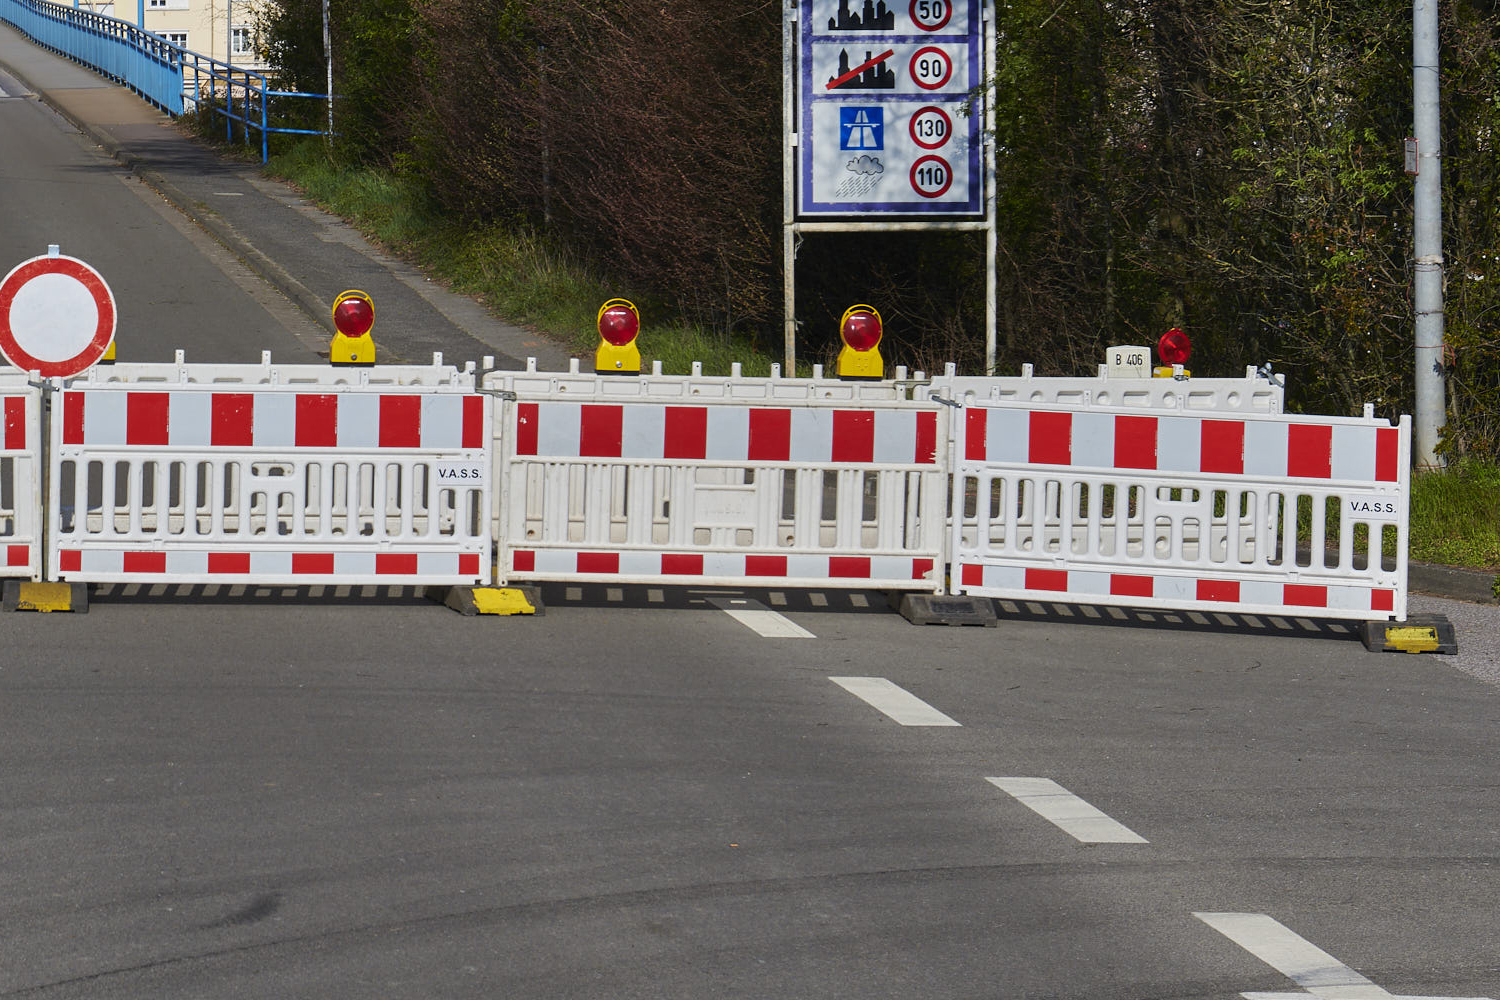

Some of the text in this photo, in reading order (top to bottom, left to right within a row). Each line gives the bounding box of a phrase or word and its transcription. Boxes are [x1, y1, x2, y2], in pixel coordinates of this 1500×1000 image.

[919, 0, 942, 20] 50
[920, 59, 942, 78] 90
[916, 119, 945, 138] 130
[917, 167, 944, 186] 110
[1115, 353, 1143, 366] B 406
[438, 468, 482, 479] V.A.S.S.
[1350, 501, 1397, 513] V.A.S.S.
